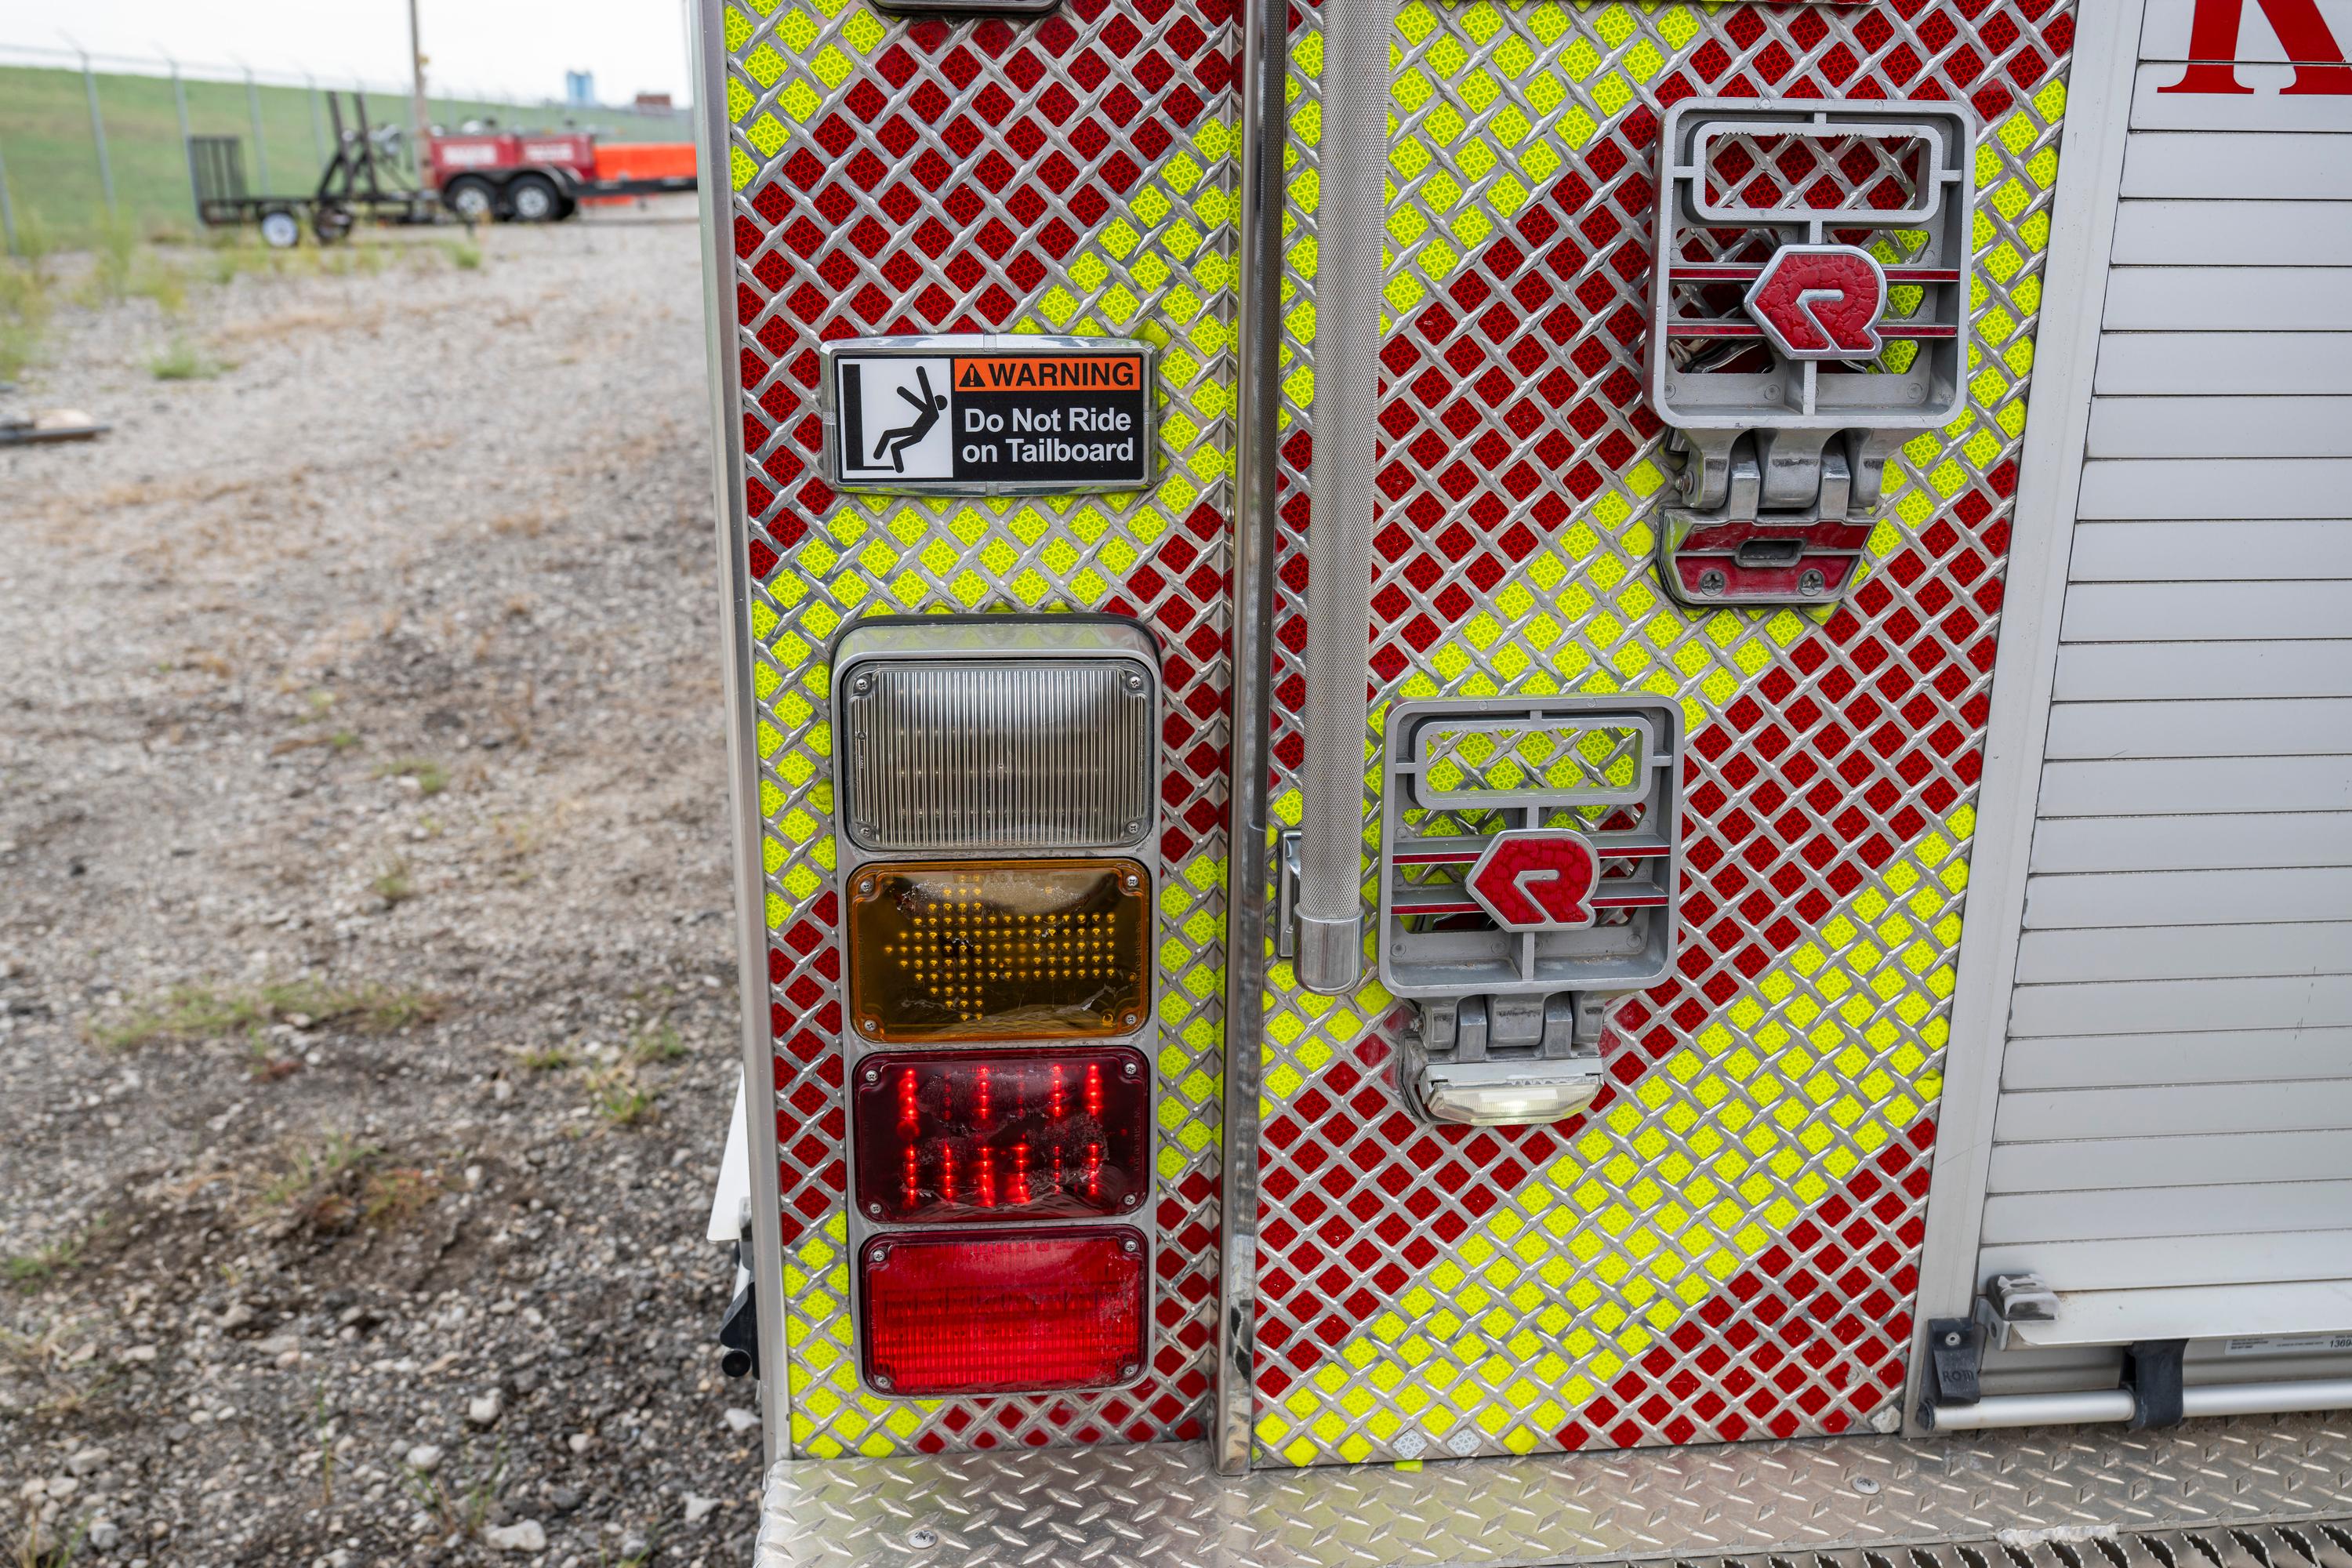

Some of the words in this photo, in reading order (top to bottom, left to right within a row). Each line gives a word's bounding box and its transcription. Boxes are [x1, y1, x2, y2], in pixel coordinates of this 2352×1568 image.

[988, 362, 1134, 387] WARNING
[965, 408, 1004, 433] Do
[1012, 408, 1062, 432] Not
[1069, 407, 1131, 431] Ride
[962, 442, 998, 463] on
[1005, 437, 1134, 463] Tailboard
